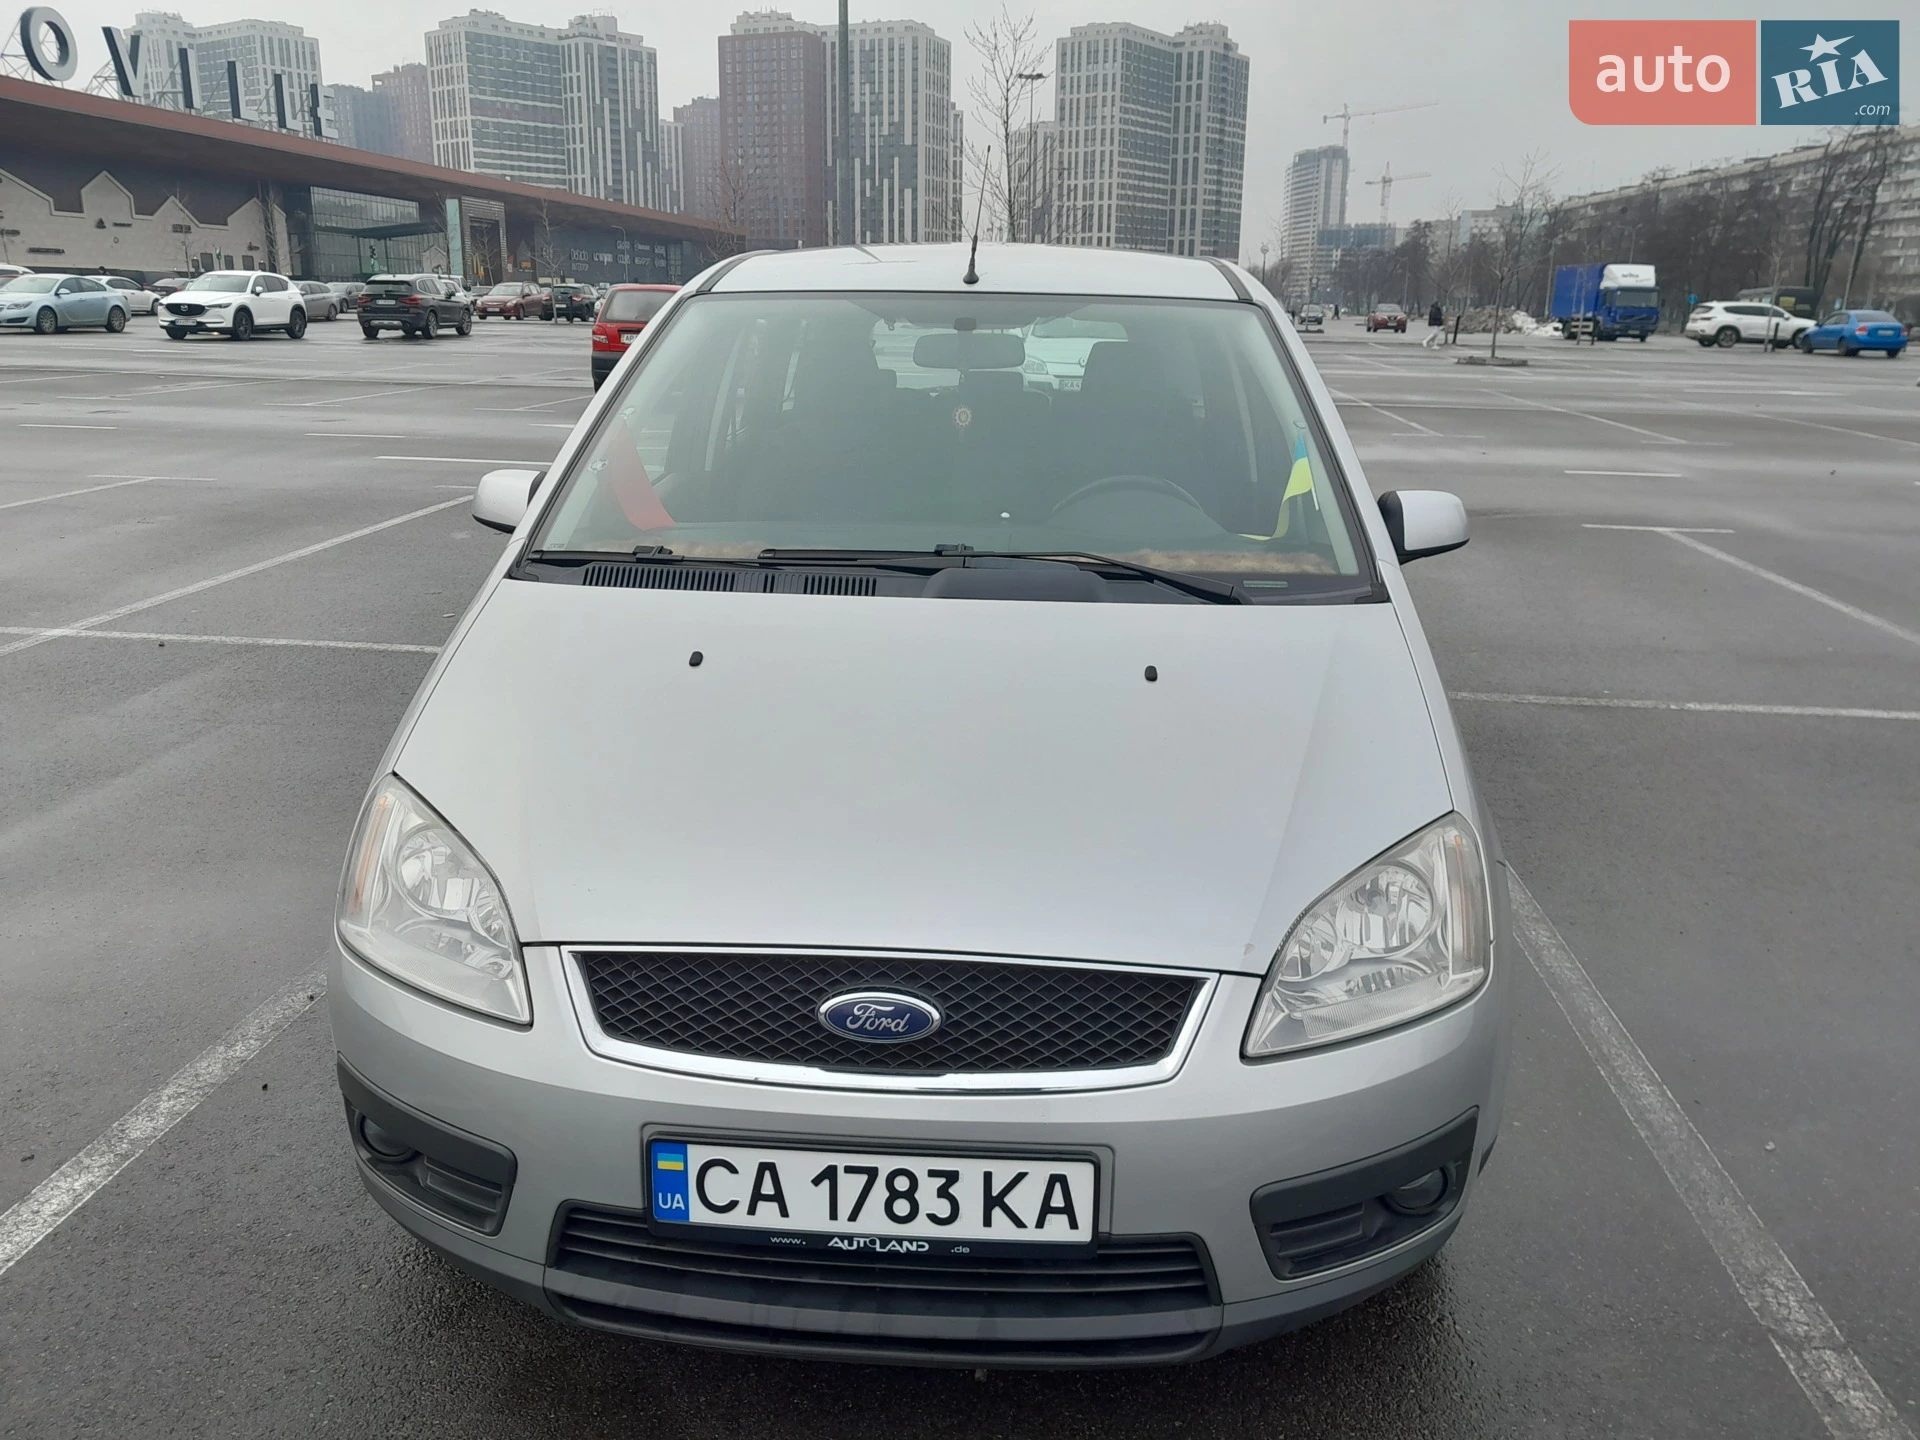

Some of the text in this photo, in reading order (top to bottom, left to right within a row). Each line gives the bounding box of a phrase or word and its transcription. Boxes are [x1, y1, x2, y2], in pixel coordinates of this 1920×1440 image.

[846, 1003, 912, 1033] Ford
[658, 1192, 686, 1212] UA
[695, 1158, 1079, 1231] CA 1783 KA
[770, 1236, 807, 1246] www.
[827, 1236, 930, 1253] AUTOLAND
